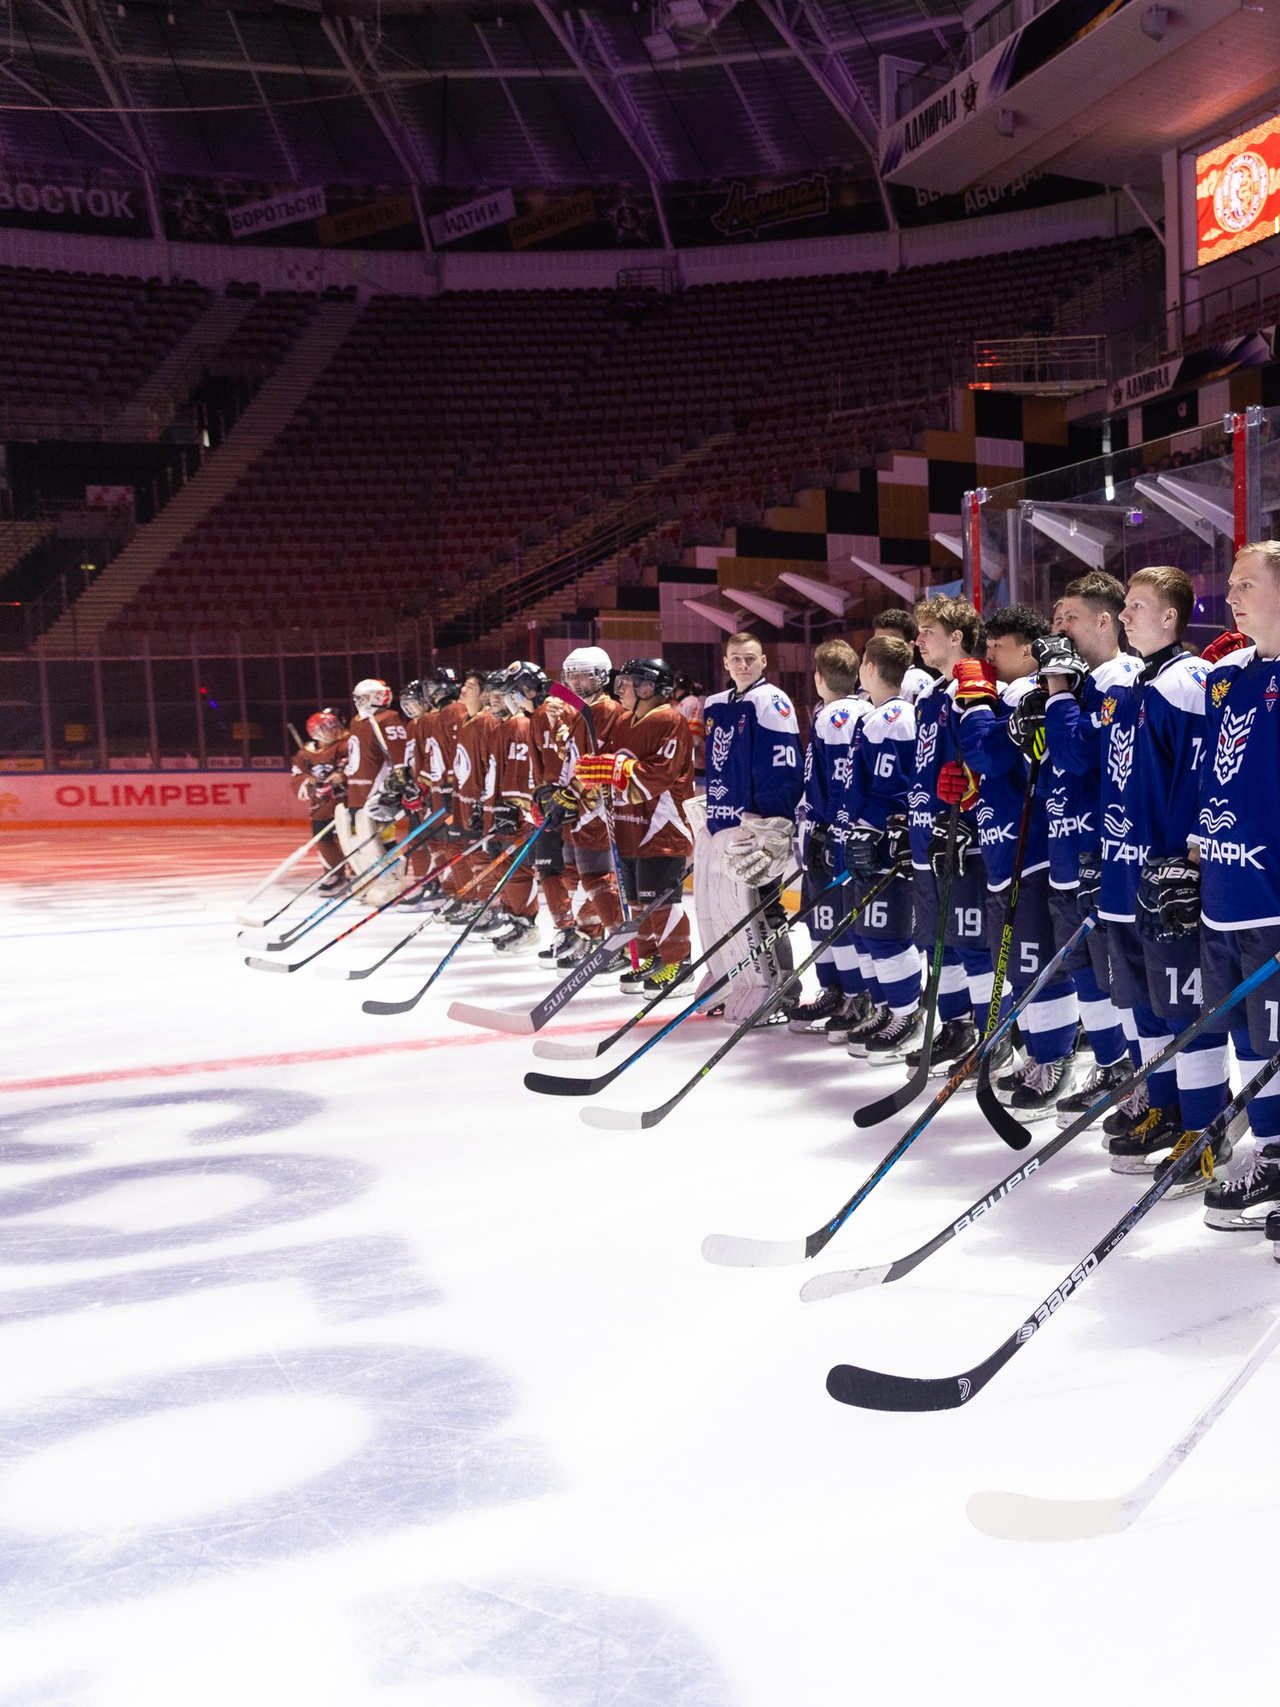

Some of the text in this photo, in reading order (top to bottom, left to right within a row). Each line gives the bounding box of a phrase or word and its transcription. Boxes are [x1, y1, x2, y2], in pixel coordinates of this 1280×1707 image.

[904, 88, 957, 154] АДМИРАЛ
[231, 191, 325, 231] БОРОТЬСЯ!
[444, 206, 485, 234] ИДТИ
[1126, 366, 1169, 398] АДМИРАЛ
[384, 726, 407, 741] 59
[508, 742, 529, 761] 12
[773, 744, 796, 768] 20
[874, 752, 896, 778] 16
[55, 783, 251, 807] OLIMPBET
[814, 905, 834, 930] 18
[863, 901, 888, 928] 16
[954, 907, 982, 937] 19
[1020, 942, 1039, 973] 5
[543, 952, 604, 1018] SUPREME
[1165, 967, 1203, 1005] 14
[953, 1157, 1041, 1236] BAUER
